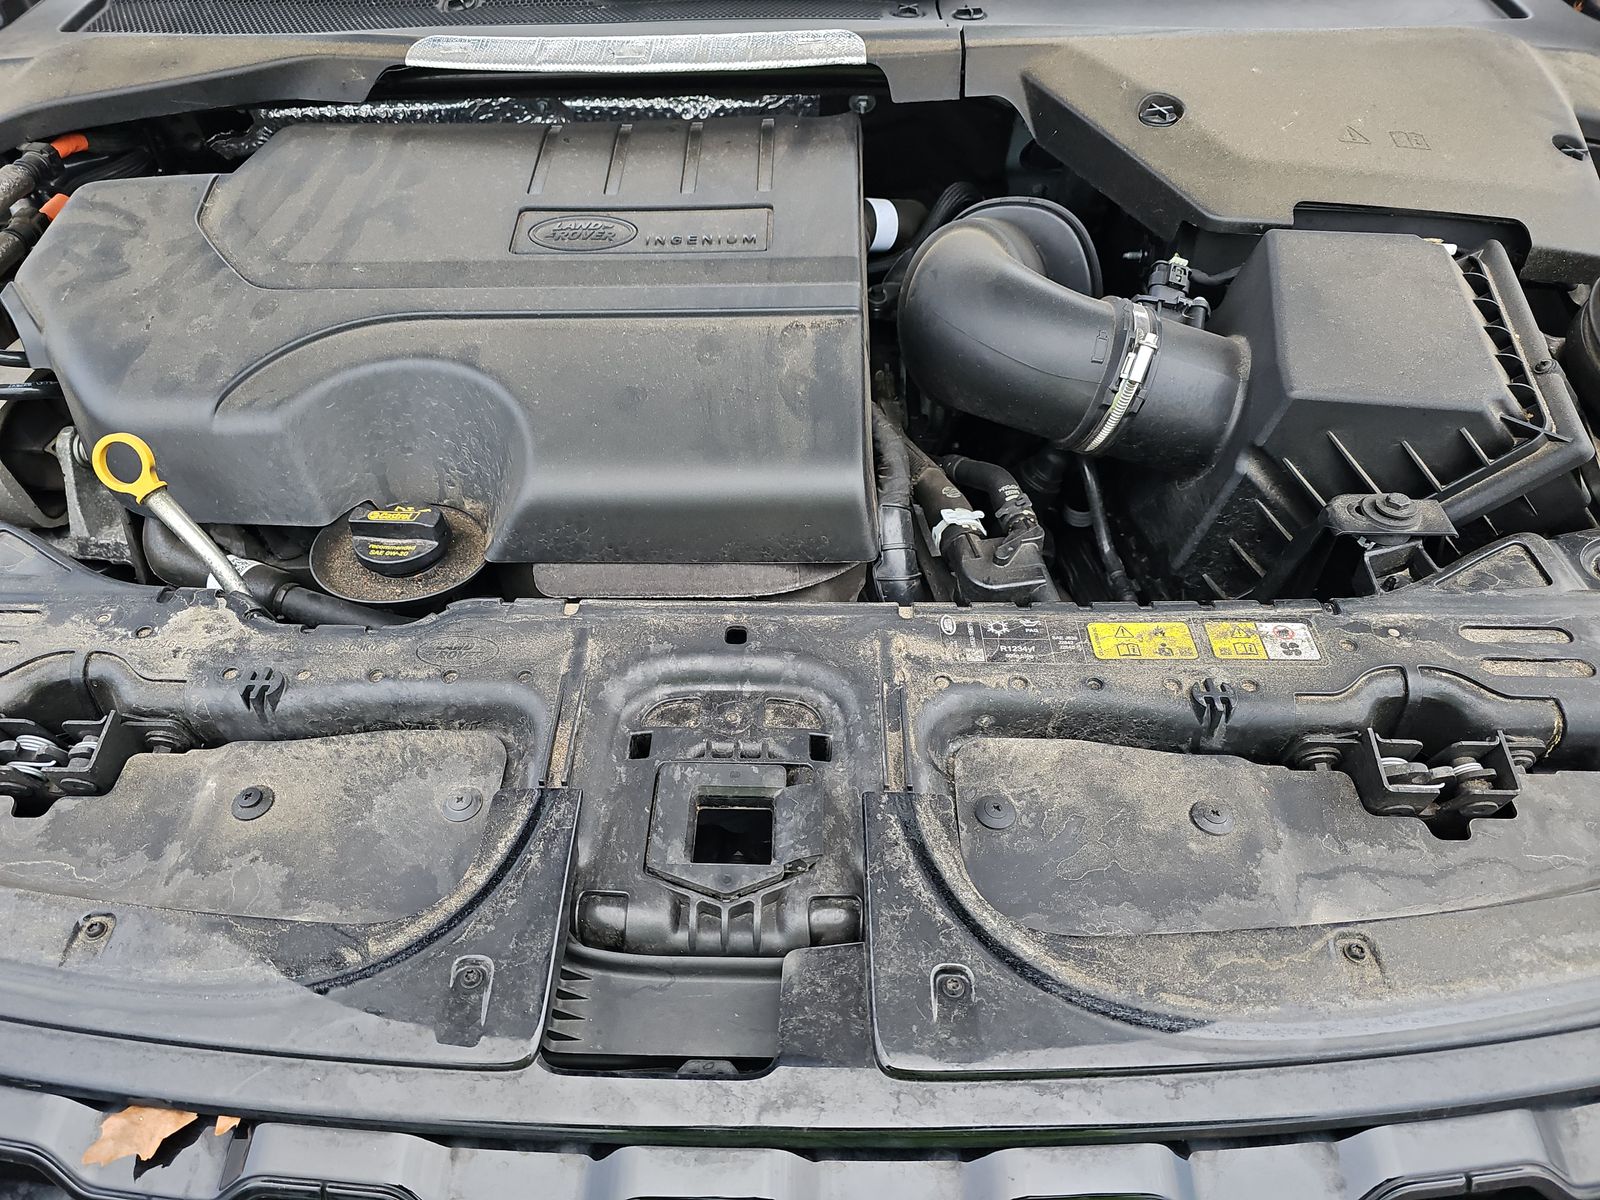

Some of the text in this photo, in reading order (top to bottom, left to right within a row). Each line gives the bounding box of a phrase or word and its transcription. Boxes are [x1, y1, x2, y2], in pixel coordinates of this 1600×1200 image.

[553, 221, 600, 231] LAND
[552, 231, 617, 241] ROVER
[645, 234, 758, 247] INGENIUM
[1000, 645, 1036, 653] R1234yf
